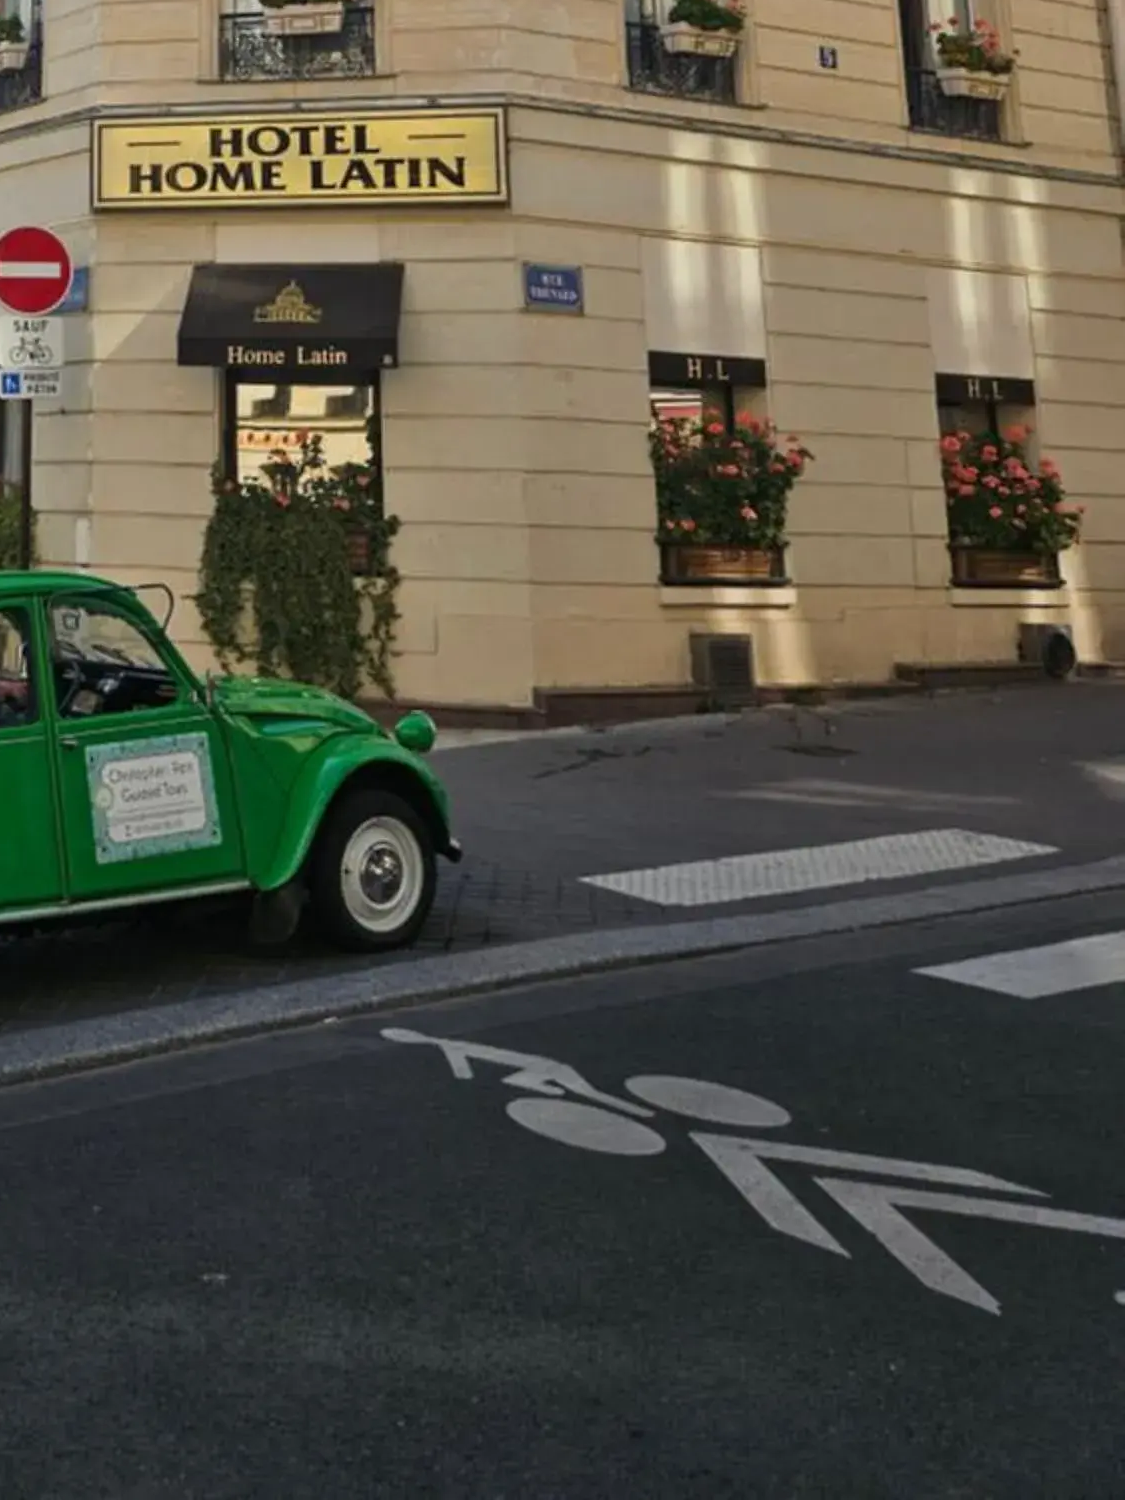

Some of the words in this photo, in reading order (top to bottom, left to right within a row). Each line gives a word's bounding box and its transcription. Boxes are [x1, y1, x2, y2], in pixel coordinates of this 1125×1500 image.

[209, 124, 380, 158] HOTEL
[129, 160, 287, 194] HOME
[309, 157, 467, 191] LATIN
[13, 320, 49, 333] SAUF
[227, 346, 285, 365] Home
[297, 345, 348, 365] Latin
